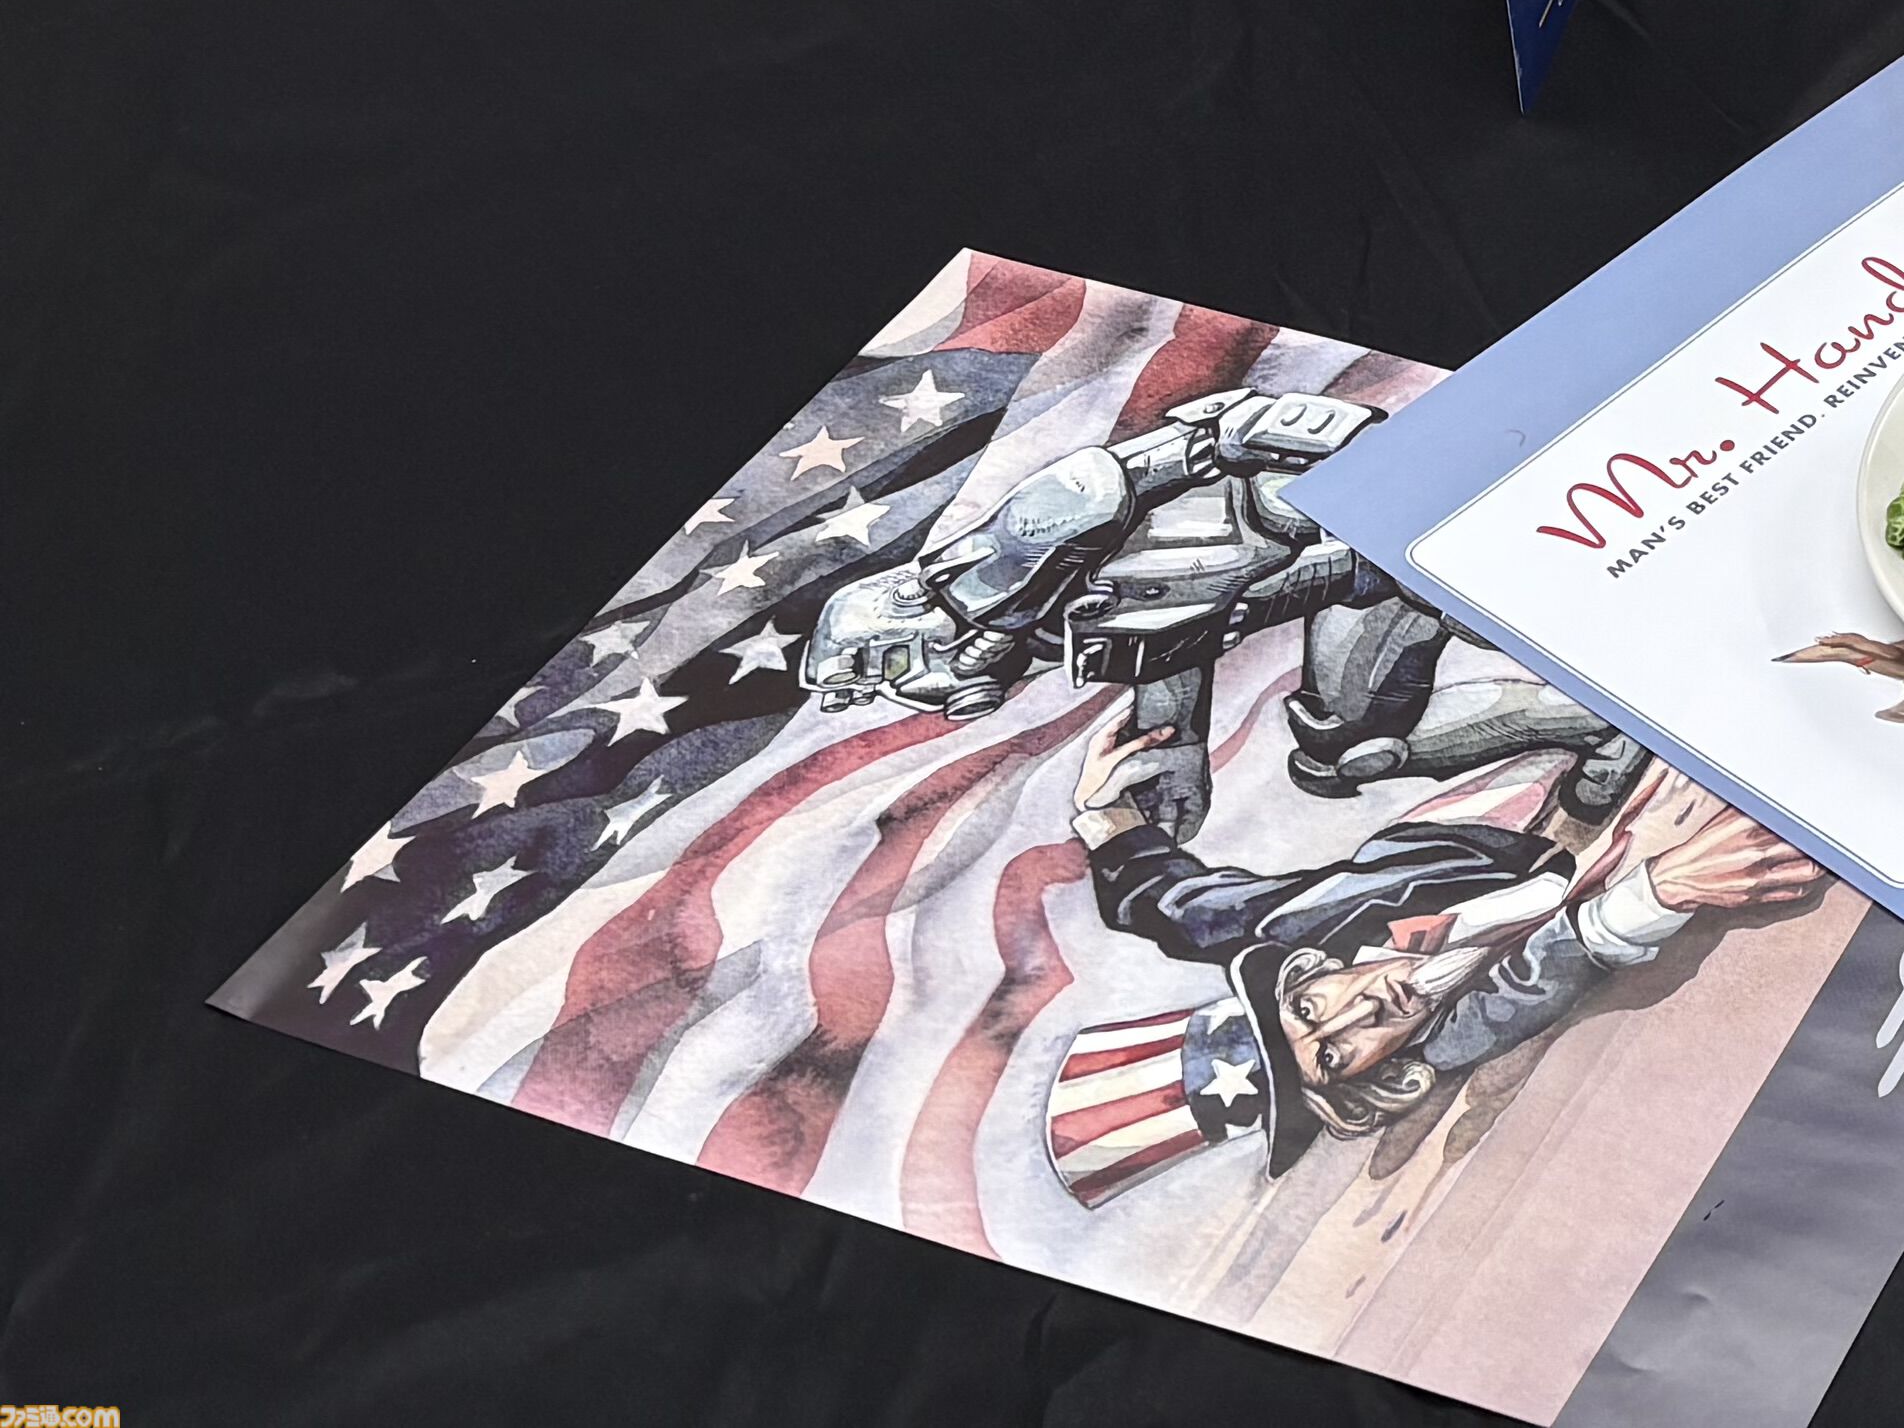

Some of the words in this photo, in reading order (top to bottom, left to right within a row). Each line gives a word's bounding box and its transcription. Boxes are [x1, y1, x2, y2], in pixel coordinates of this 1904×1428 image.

[1537, 437, 1737, 550] Mr.
[1605, 515, 1686, 580] MAN'S
[1686, 472, 1739, 515] BEST
[1739, 413, 1824, 474] FRIEND.
